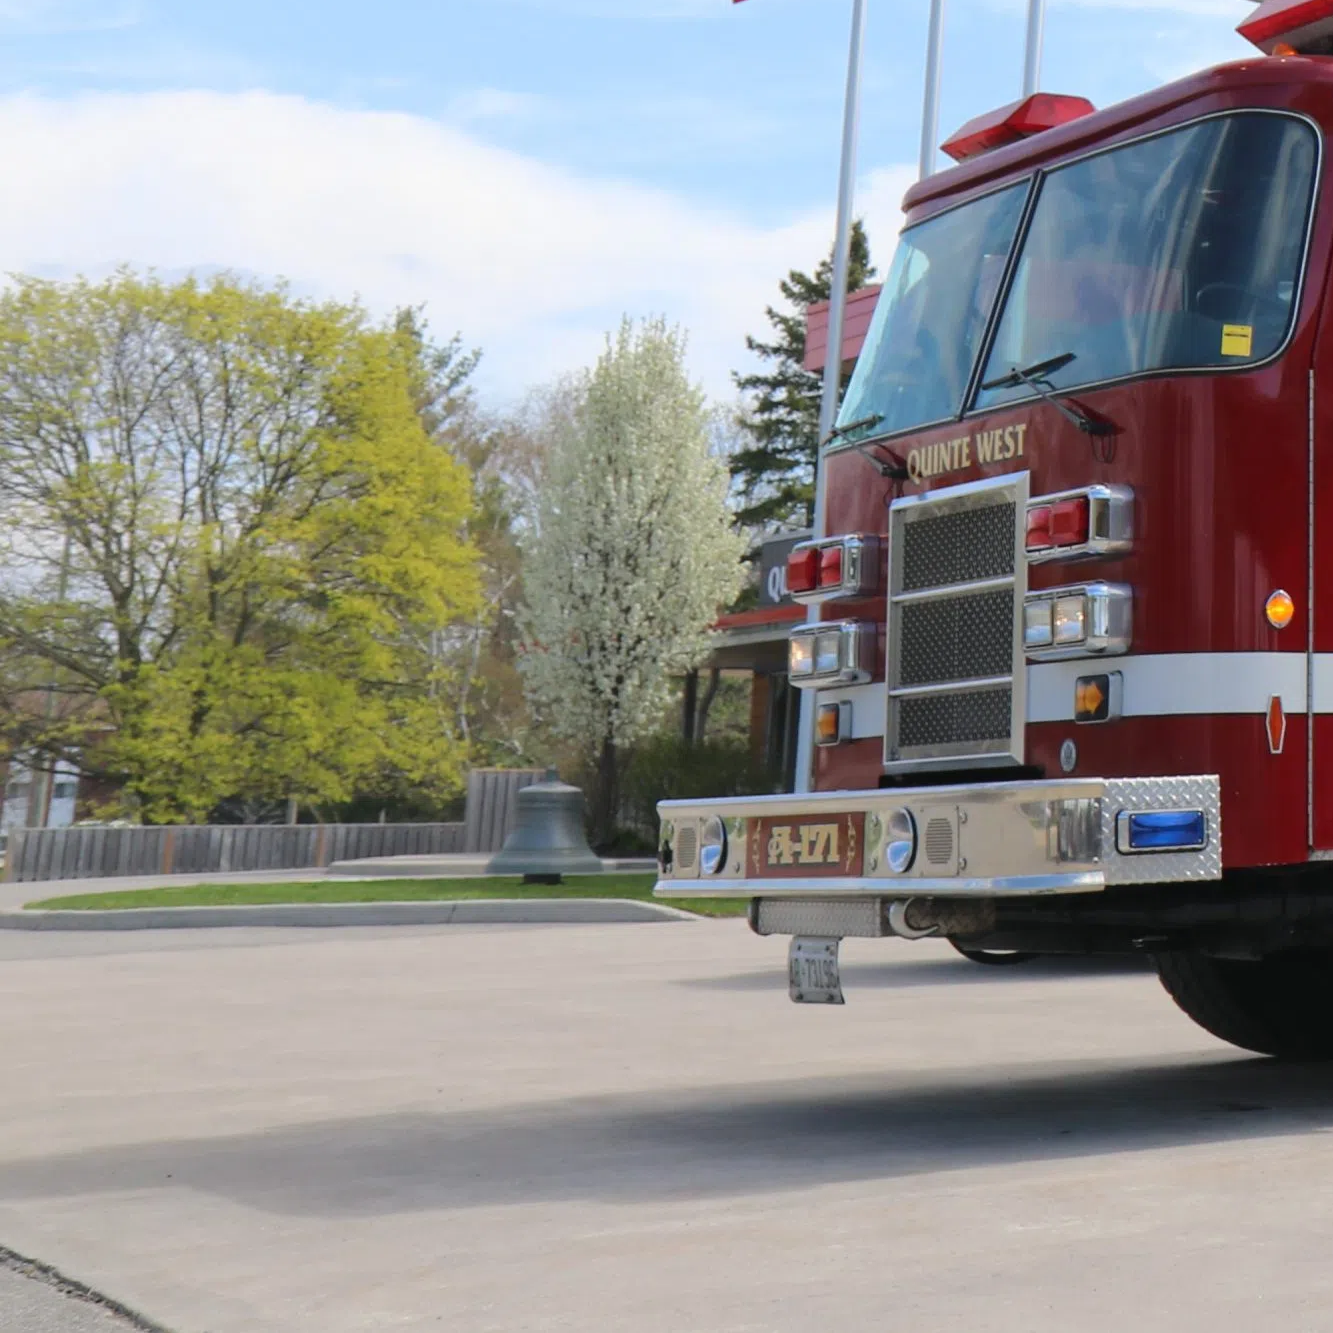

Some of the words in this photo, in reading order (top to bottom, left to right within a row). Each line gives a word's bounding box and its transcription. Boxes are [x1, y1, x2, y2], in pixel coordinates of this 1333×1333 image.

[907, 435, 971, 485] QUINTE
[975, 424, 1026, 463] WEST
[767, 823, 841, 866] A-171
